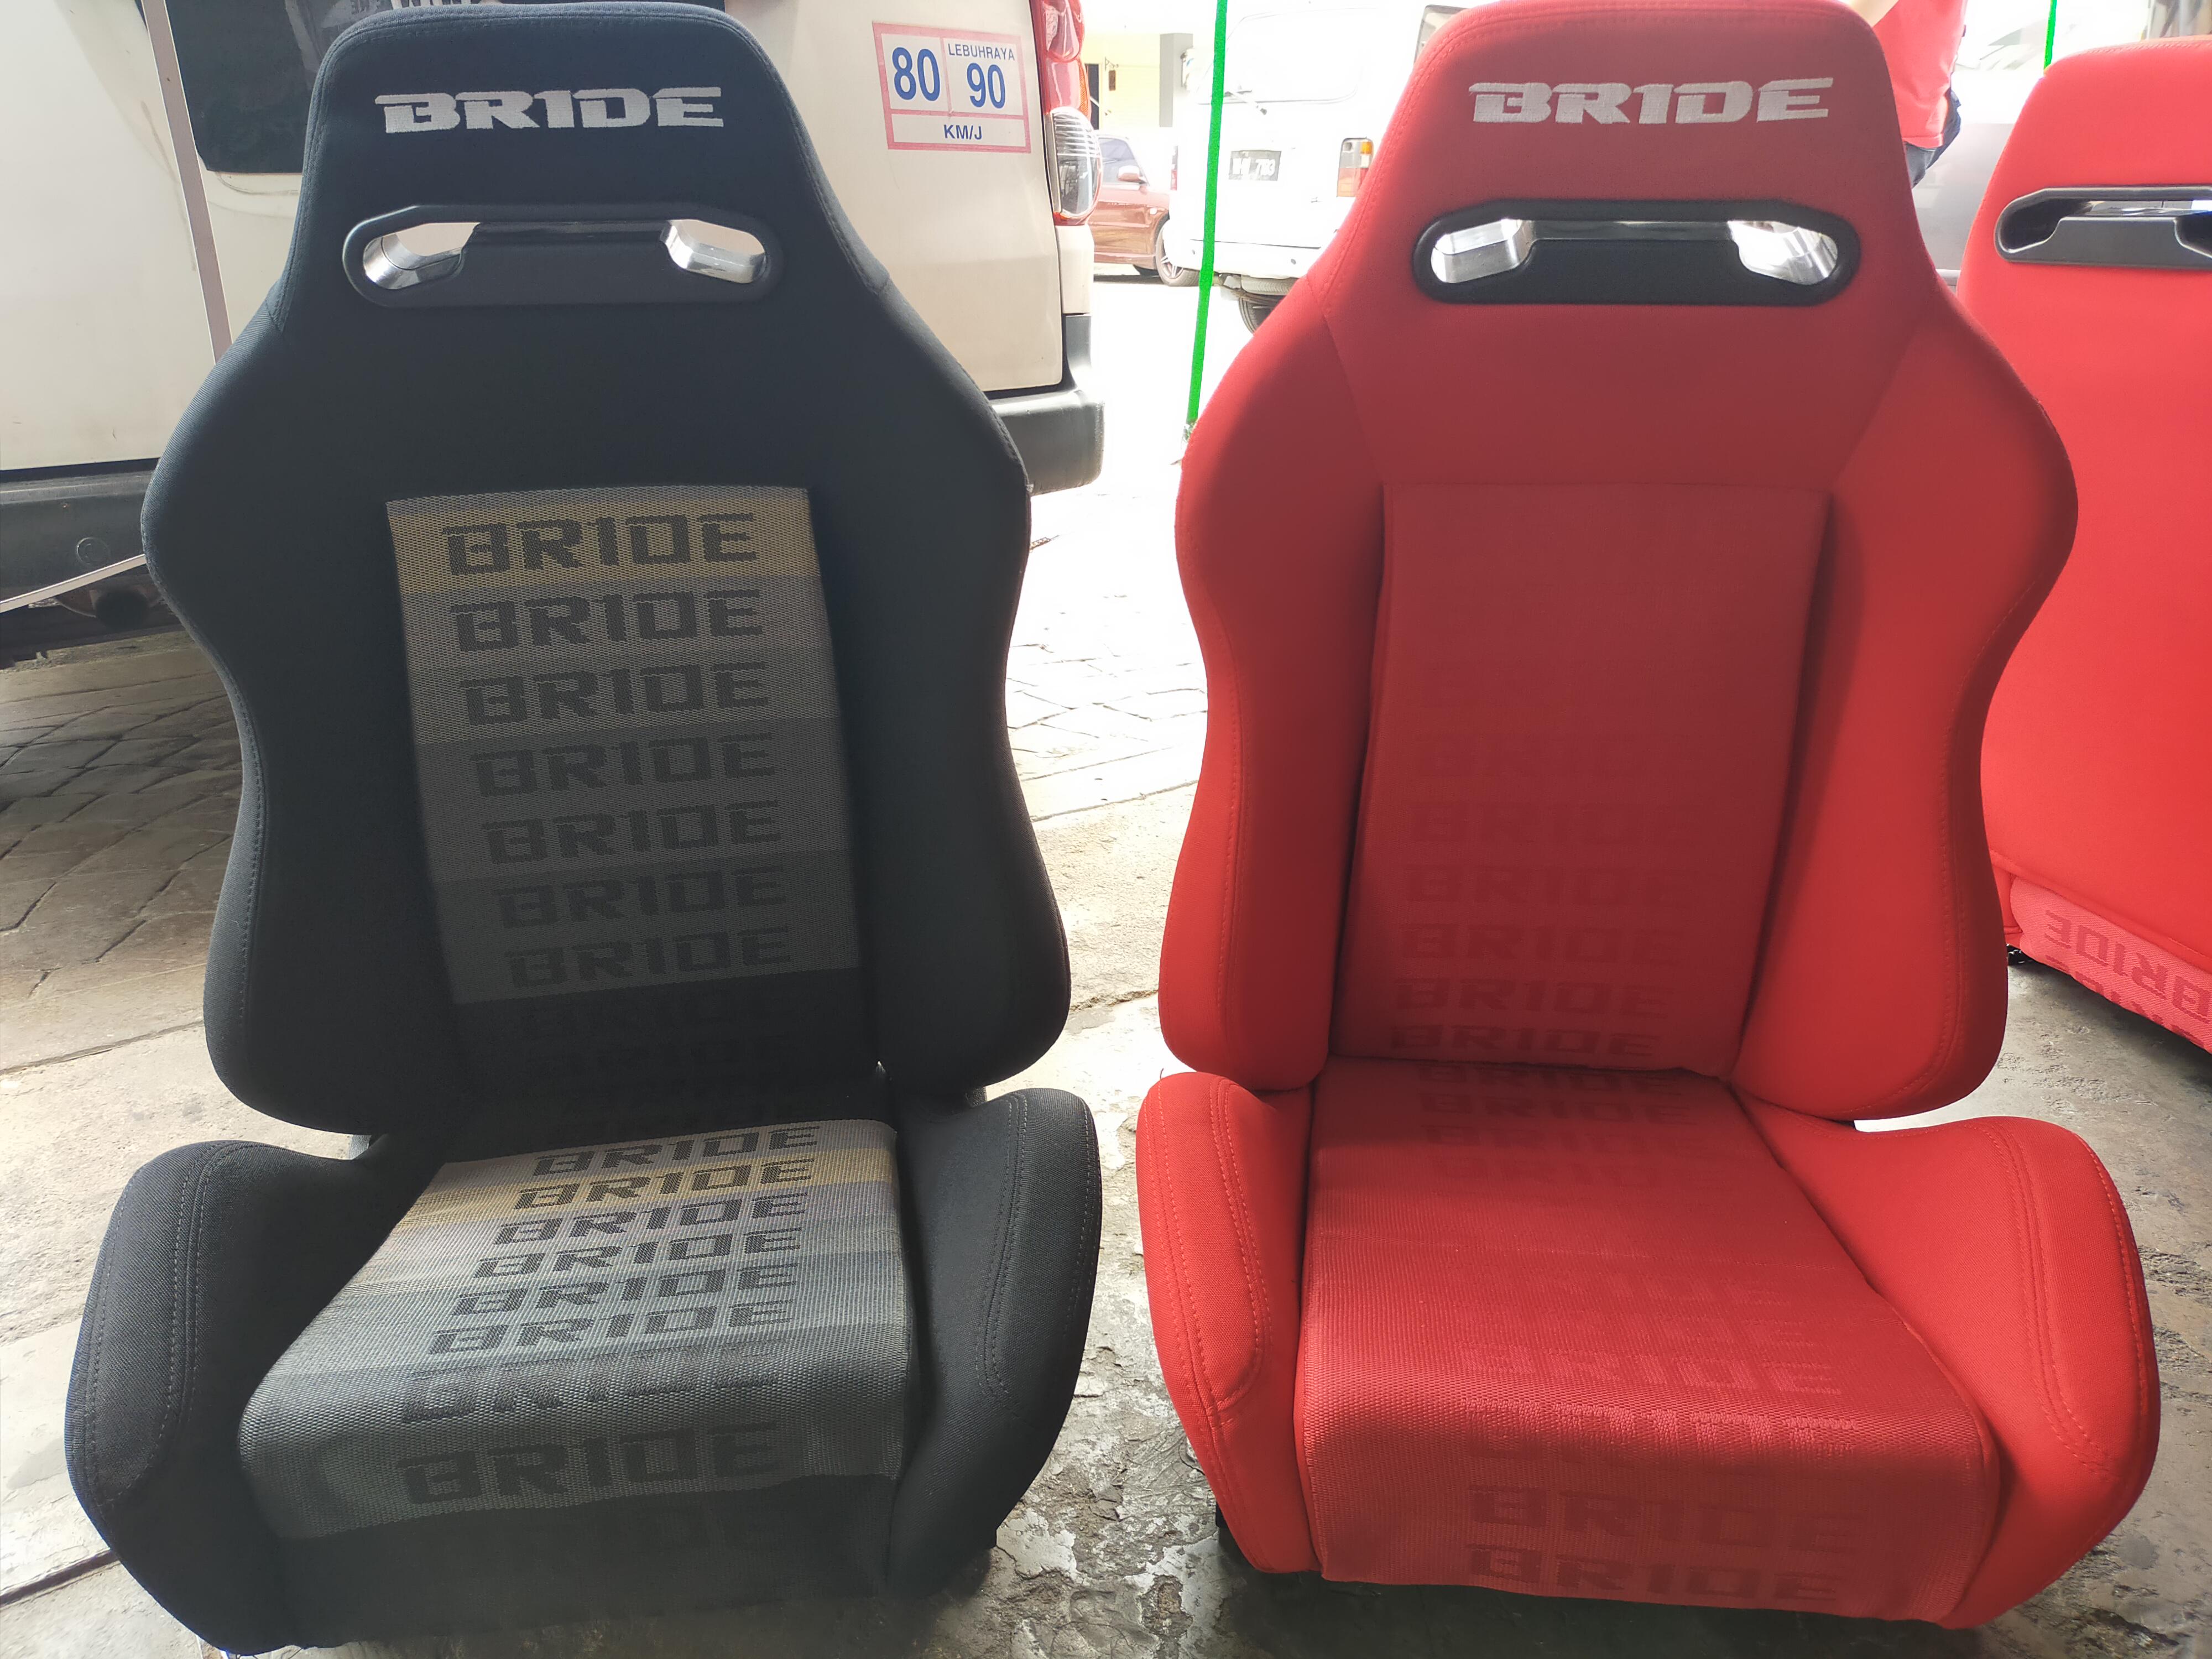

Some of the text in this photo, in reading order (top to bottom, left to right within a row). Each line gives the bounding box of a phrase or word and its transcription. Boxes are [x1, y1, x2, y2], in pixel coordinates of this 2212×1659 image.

[892, 47, 940, 101] 80
[948, 44, 1015, 60] LEBUHRAYA
[375, 87, 723, 133] BRIDE
[967, 63, 1005, 108] 90
[1468, 77, 1833, 124] BRIDE
[943, 124, 982, 140] KM/J
[444, 512, 757, 576] BRIDE
[450, 589, 764, 651] BRIDE
[460, 667, 769, 726] BRIDE
[469, 732, 775, 796] BRIDE
[481, 800, 780, 864] BRIDE
[493, 866, 785, 928] BRIDE
[505, 927, 792, 988] BRIDE
[532, 1125, 820, 1176] BRIDE
[513, 1158, 814, 1210] BRIDE
[493, 1192, 808, 1244] BRIDE
[473, 1227, 802, 1278] BRIDE
[452, 1264, 797, 1316] BRIDE
[429, 1300, 793, 1354] BRIDE
[396, 1423, 780, 1504] BRIDE
